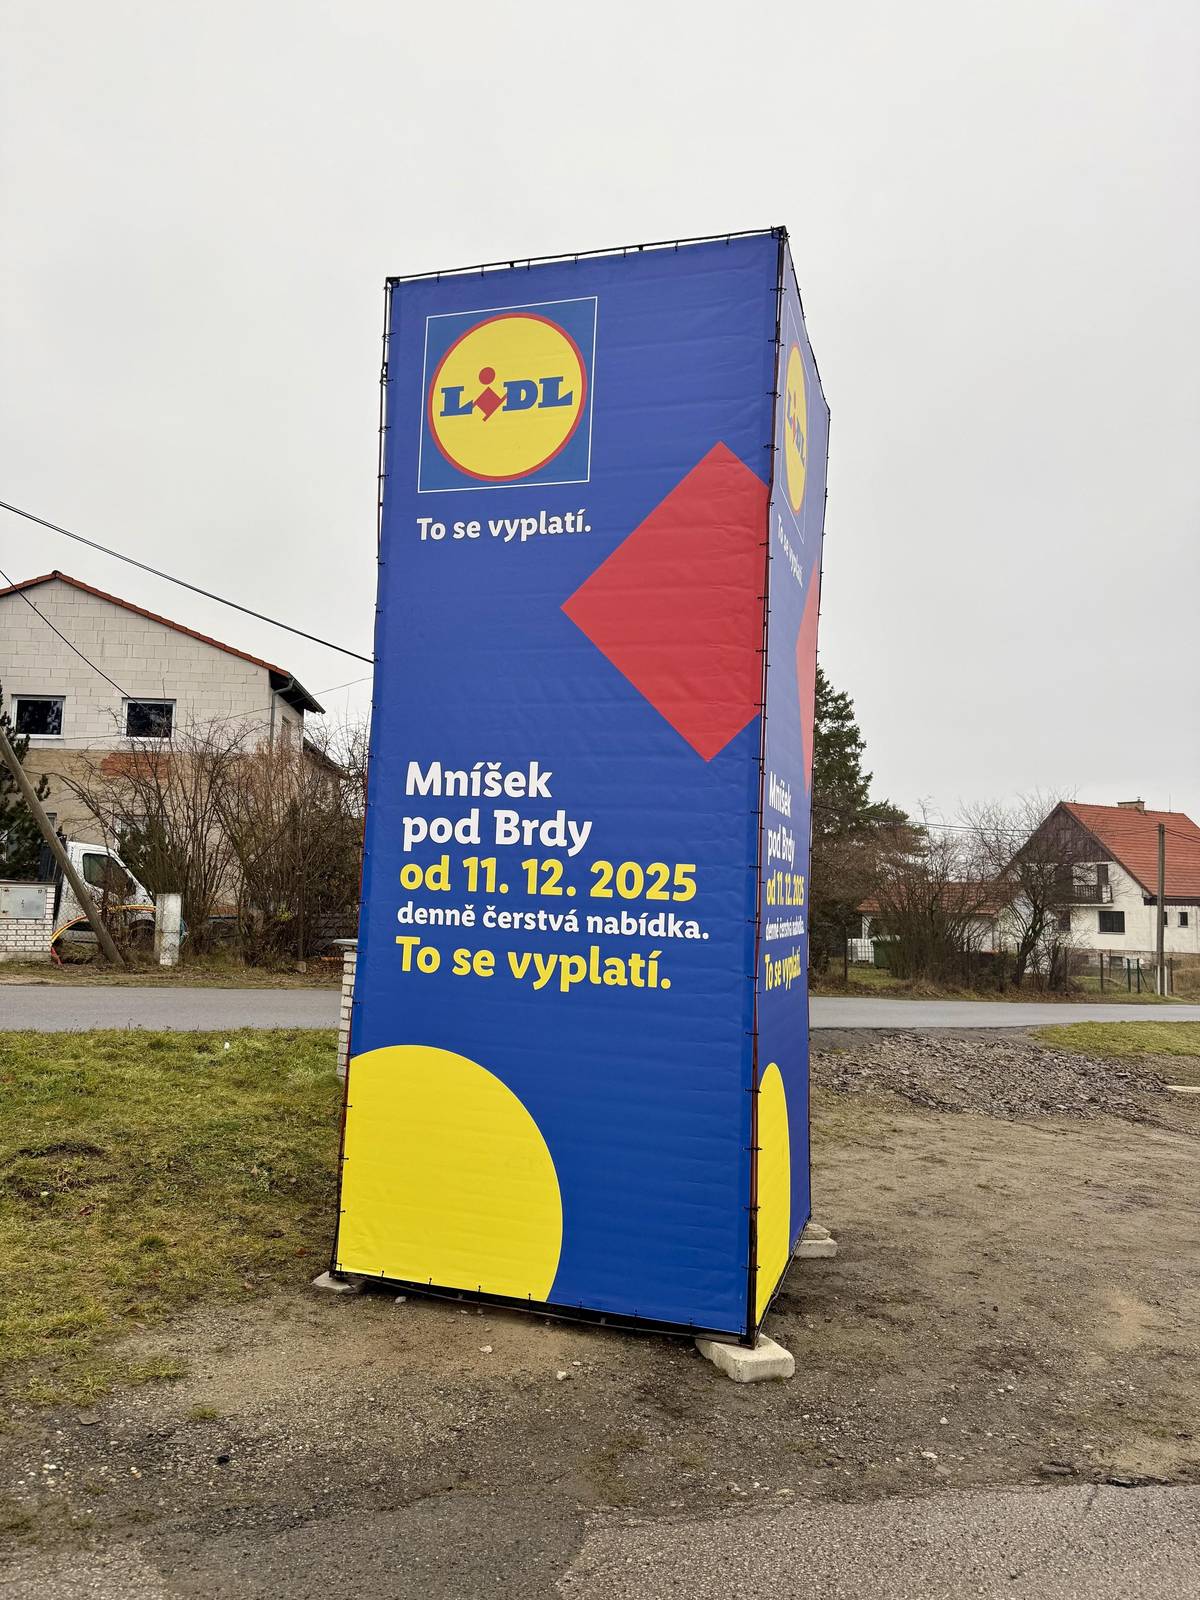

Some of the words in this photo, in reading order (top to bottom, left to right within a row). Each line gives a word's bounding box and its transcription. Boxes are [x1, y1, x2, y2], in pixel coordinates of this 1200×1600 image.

[439, 366, 574, 422] LIDL
[416, 517, 446, 541] To
[453, 516, 481, 539] se
[488, 508, 592, 542] vyplatí.
[405, 760, 553, 798] Mníšek
[769, 770, 791, 818] Mníšek
[402, 808, 481, 852] pod
[493, 809, 593, 857] Brdy
[768, 823, 781, 866] pod
[782, 825, 795, 871] Brdy
[400, 854, 451, 892] od
[462, 856, 509, 894] 11.
[521, 858, 577, 897] 12.
[589, 860, 697, 902] 2025
[766, 869, 776, 906] od
[396, 901, 476, 927] denně
[482, 904, 579, 933] čerstvá
[587, 910, 710, 940] nabídka.
[395, 935, 441, 974] To
[452, 947, 496, 977] se
[507, 945, 671, 992] vyplatí.
[764, 953, 774, 992] To
[774, 959, 782, 988] se
